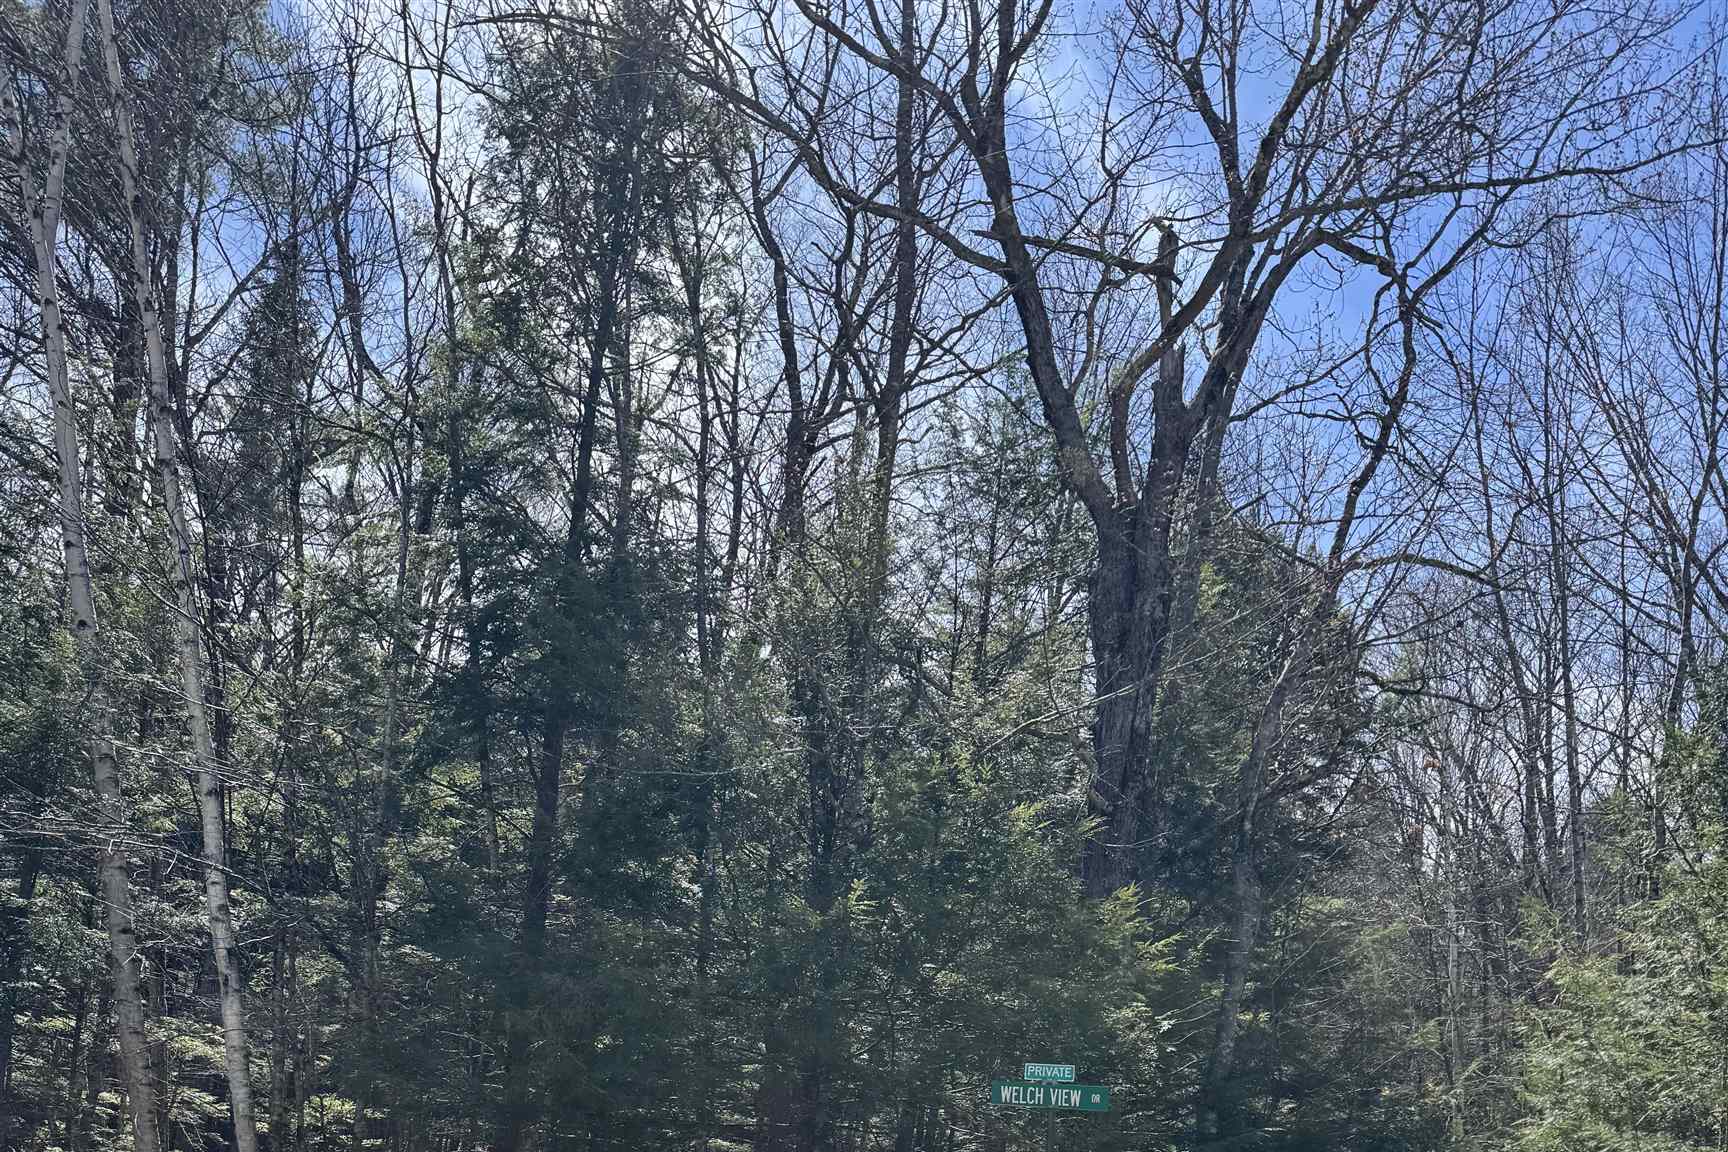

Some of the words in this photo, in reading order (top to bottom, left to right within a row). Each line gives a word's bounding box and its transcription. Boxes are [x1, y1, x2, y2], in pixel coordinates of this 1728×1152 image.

[1027, 1065, 1073, 1078] PRIVATE
[1001, 1085, 1044, 1105] WELCH
[1050, 1088, 1081, 1107] VIEW
[1091, 1093, 1101, 1104] DR
